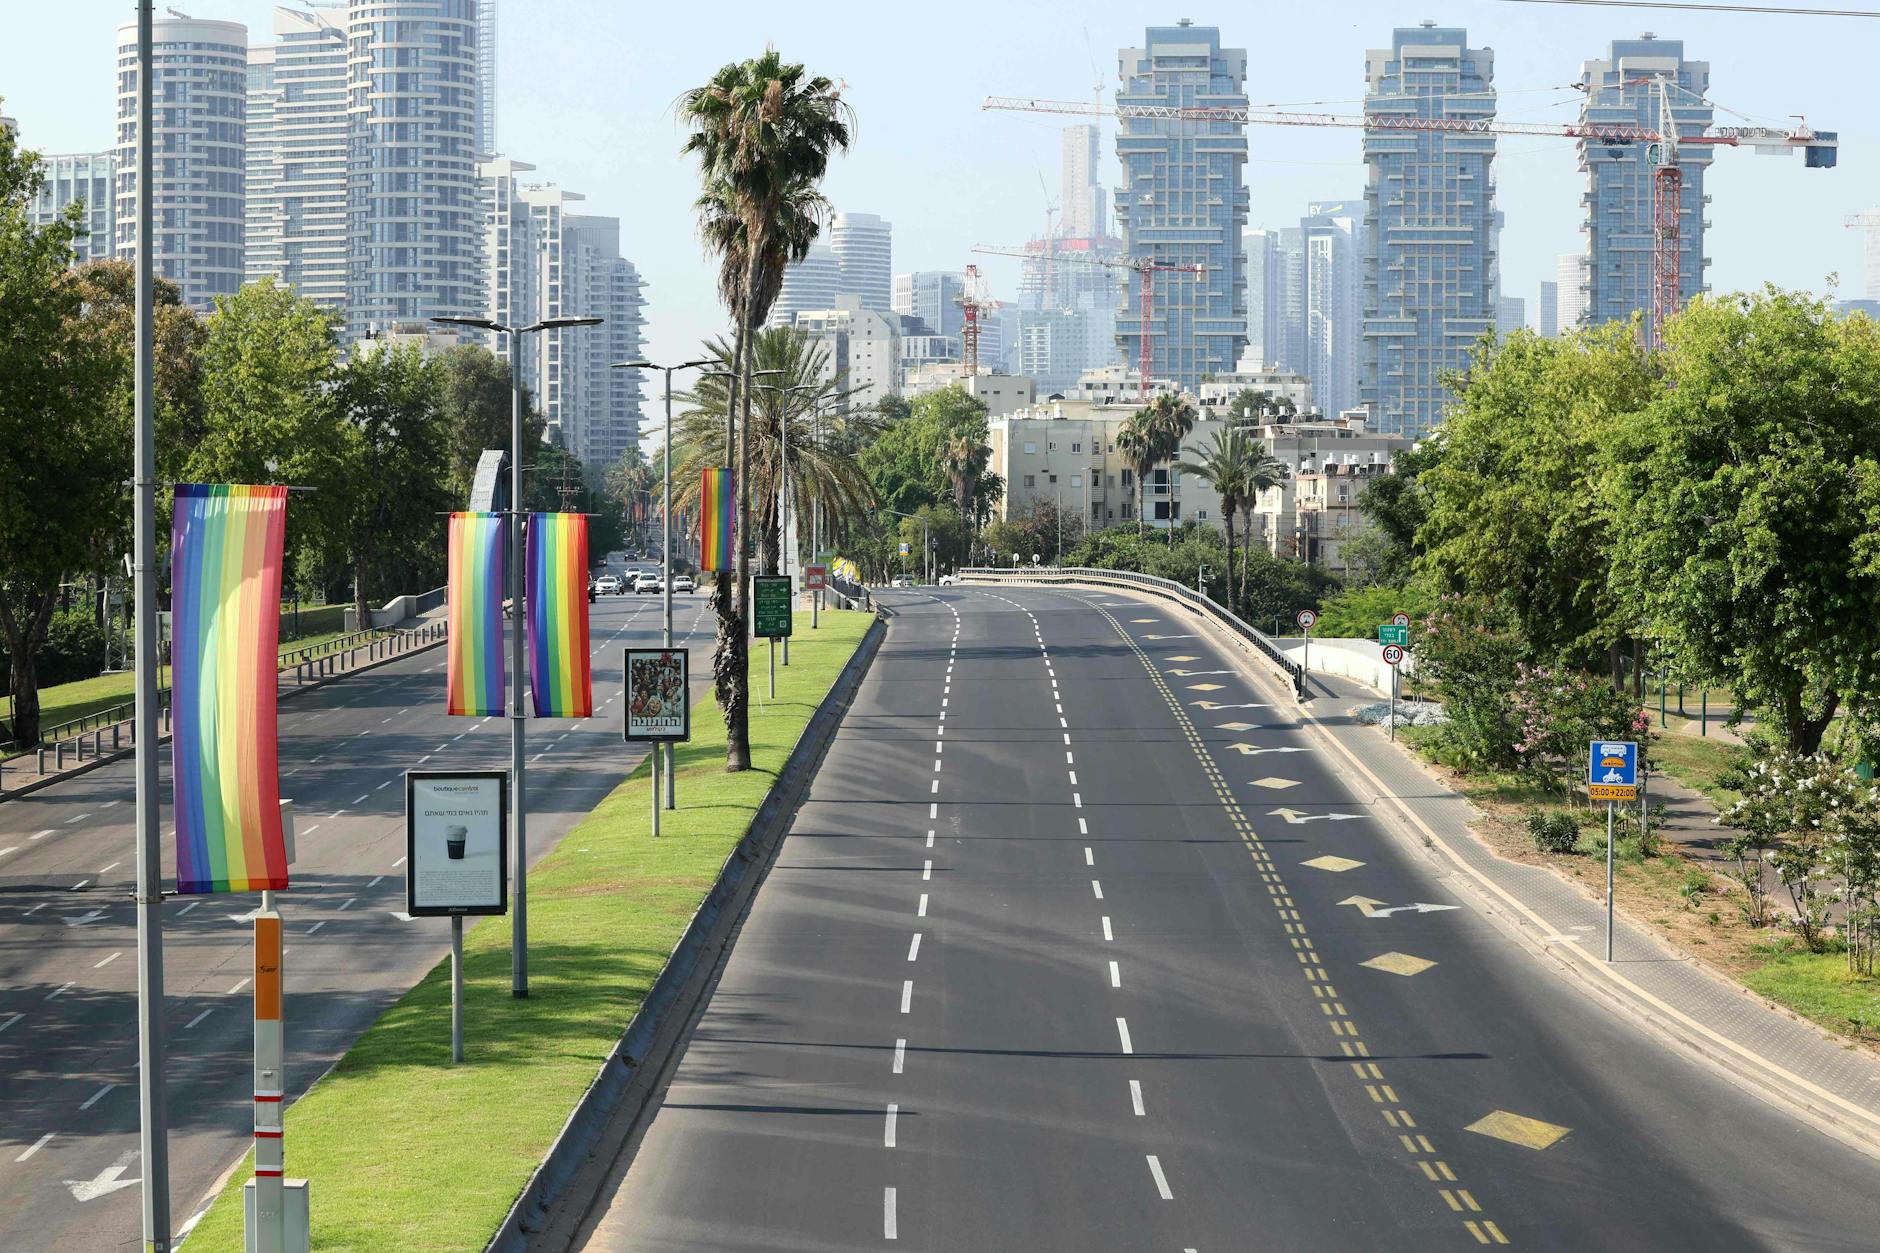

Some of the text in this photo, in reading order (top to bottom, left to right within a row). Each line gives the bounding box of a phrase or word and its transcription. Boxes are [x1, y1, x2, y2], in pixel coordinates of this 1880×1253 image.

[1310, 205, 1322, 215] EY
[1386, 649, 1400, 659] 60
[632, 716, 681, 726] החתונה
[1590, 788, 1634, 797] 05:00 22:00
